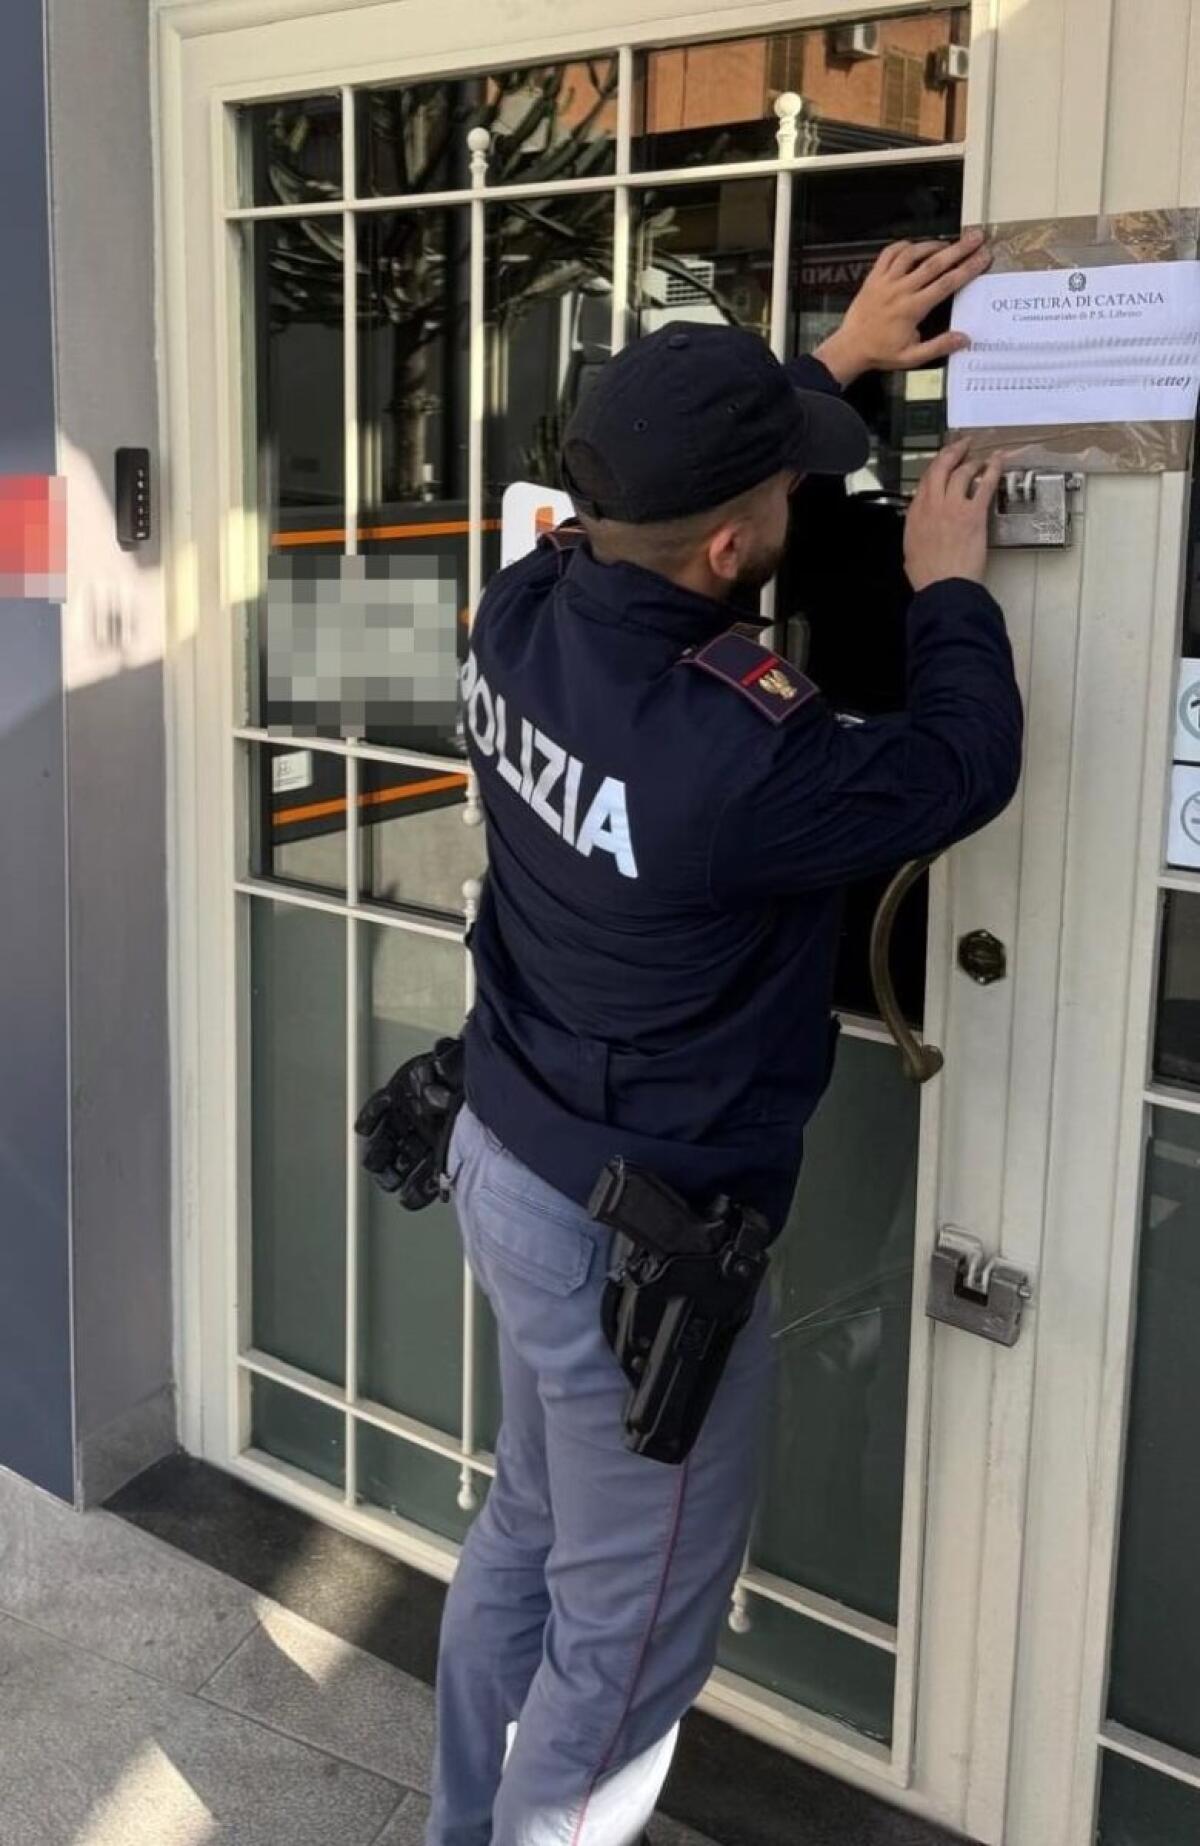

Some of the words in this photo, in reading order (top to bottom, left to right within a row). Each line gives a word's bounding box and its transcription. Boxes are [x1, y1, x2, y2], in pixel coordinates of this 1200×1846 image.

[992, 296, 1071, 312] QUESTURA
[1076, 295, 1090, 308] DI
[1094, 291, 1164, 307] CATANIA
[460, 647, 639, 879] POLIZIA
